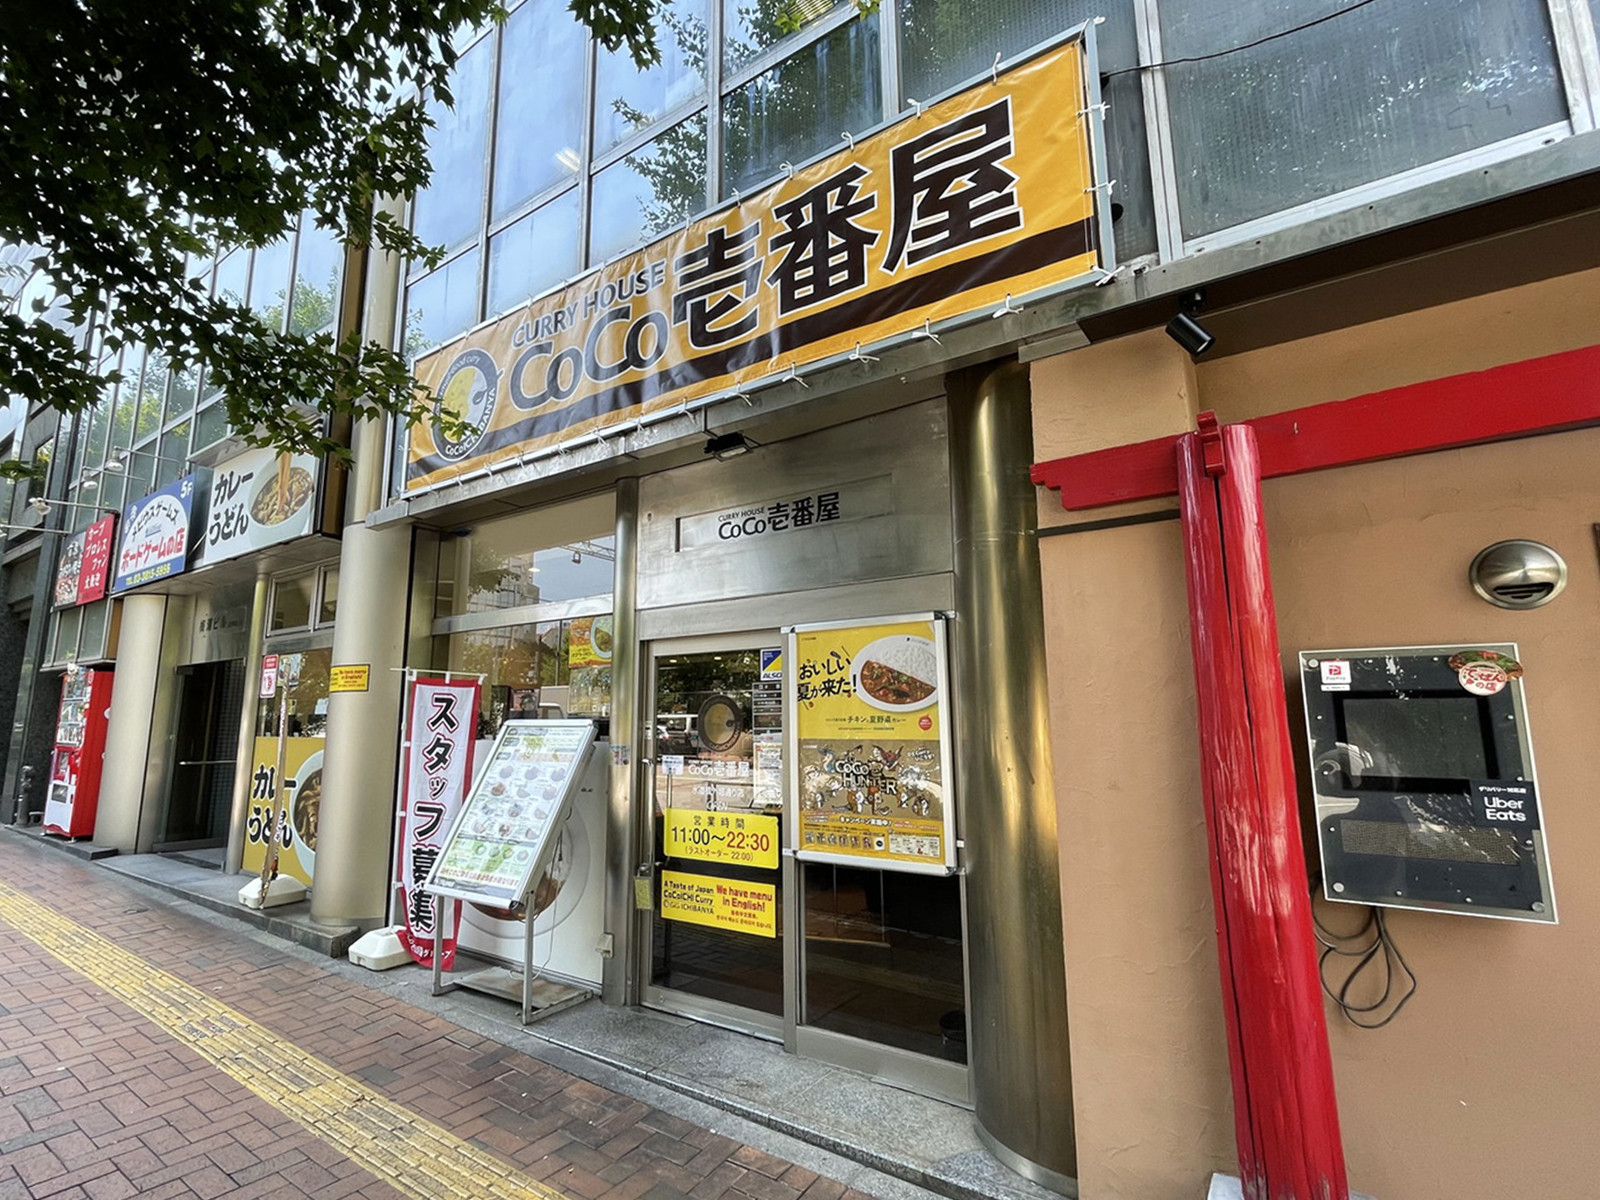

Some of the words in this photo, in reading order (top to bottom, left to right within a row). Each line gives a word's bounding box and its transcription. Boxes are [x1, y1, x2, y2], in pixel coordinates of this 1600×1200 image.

[510, 94, 1025, 412] CoCo壱番屋
[512, 302, 578, 348] CURRY
[583, 259, 666, 318] HOUSE
[180, 481, 193, 499] 5F
[213, 470, 254, 508] カレー
[209, 503, 249, 546] うどん
[718, 511, 739, 522] CURRY
[741, 506, 765, 517] HOUSE
[718, 491, 840, 540] CoCo壱番屋
[121, 527, 185, 573] ボードゲームの店
[799, 651, 851, 680] おいしい
[797, 674, 857, 702] 夏が来た!
[842, 773, 898, 795] HUNTER
[409, 695, 456, 931] スタッフ募集
[1483, 796, 1524, 809] Uber
[693, 815, 745, 829] 営業時間
[1485, 808, 1527, 822] Eats
[669, 881, 686, 890] Taste
[695, 885, 715, 894] Japan
[716, 885, 727, 895] We
[729, 886, 748, 898] have
[750, 891, 773, 902] menu
[695, 894, 713, 905] Curry
[722, 897, 730, 906] in
[731, 898, 766, 913] English!
